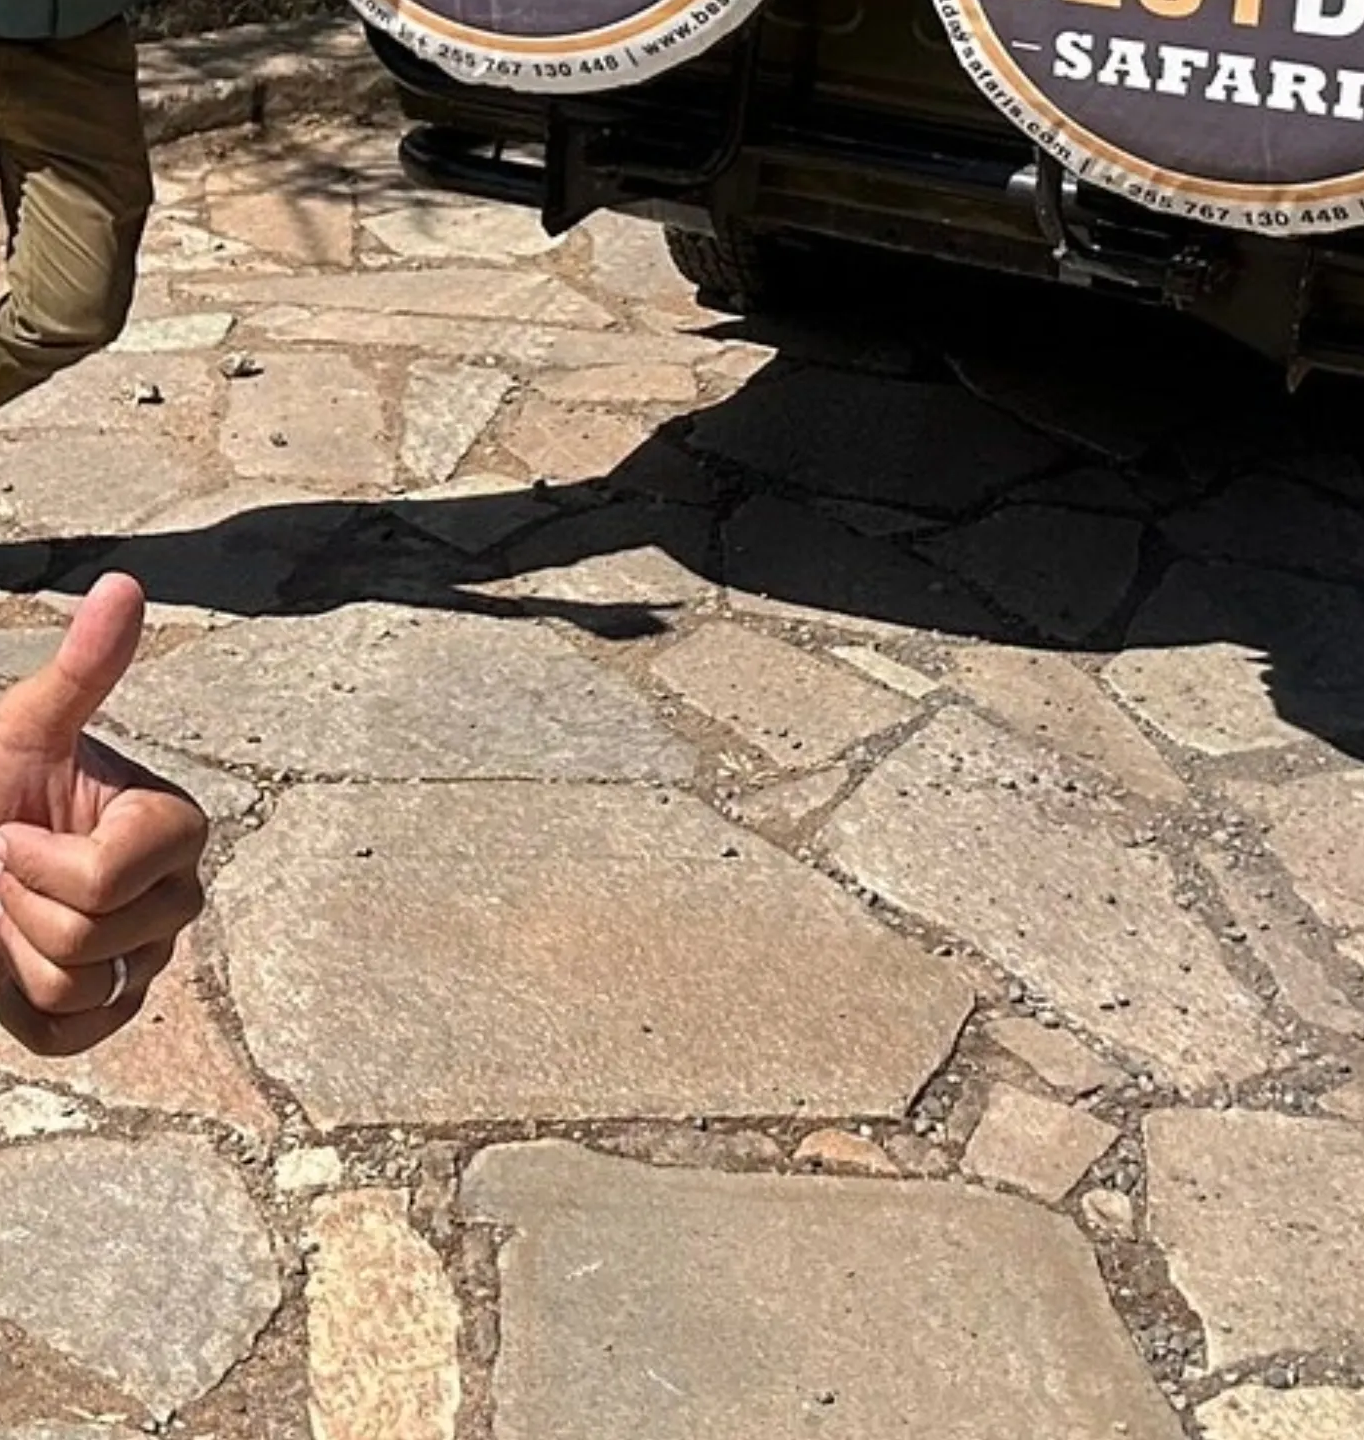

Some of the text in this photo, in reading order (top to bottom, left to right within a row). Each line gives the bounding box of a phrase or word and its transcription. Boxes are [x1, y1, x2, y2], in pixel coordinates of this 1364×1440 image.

[1184, 200, 1231, 222] 767
[1241, 210, 1289, 227] 130
[1299, 205, 1350, 224] 448
